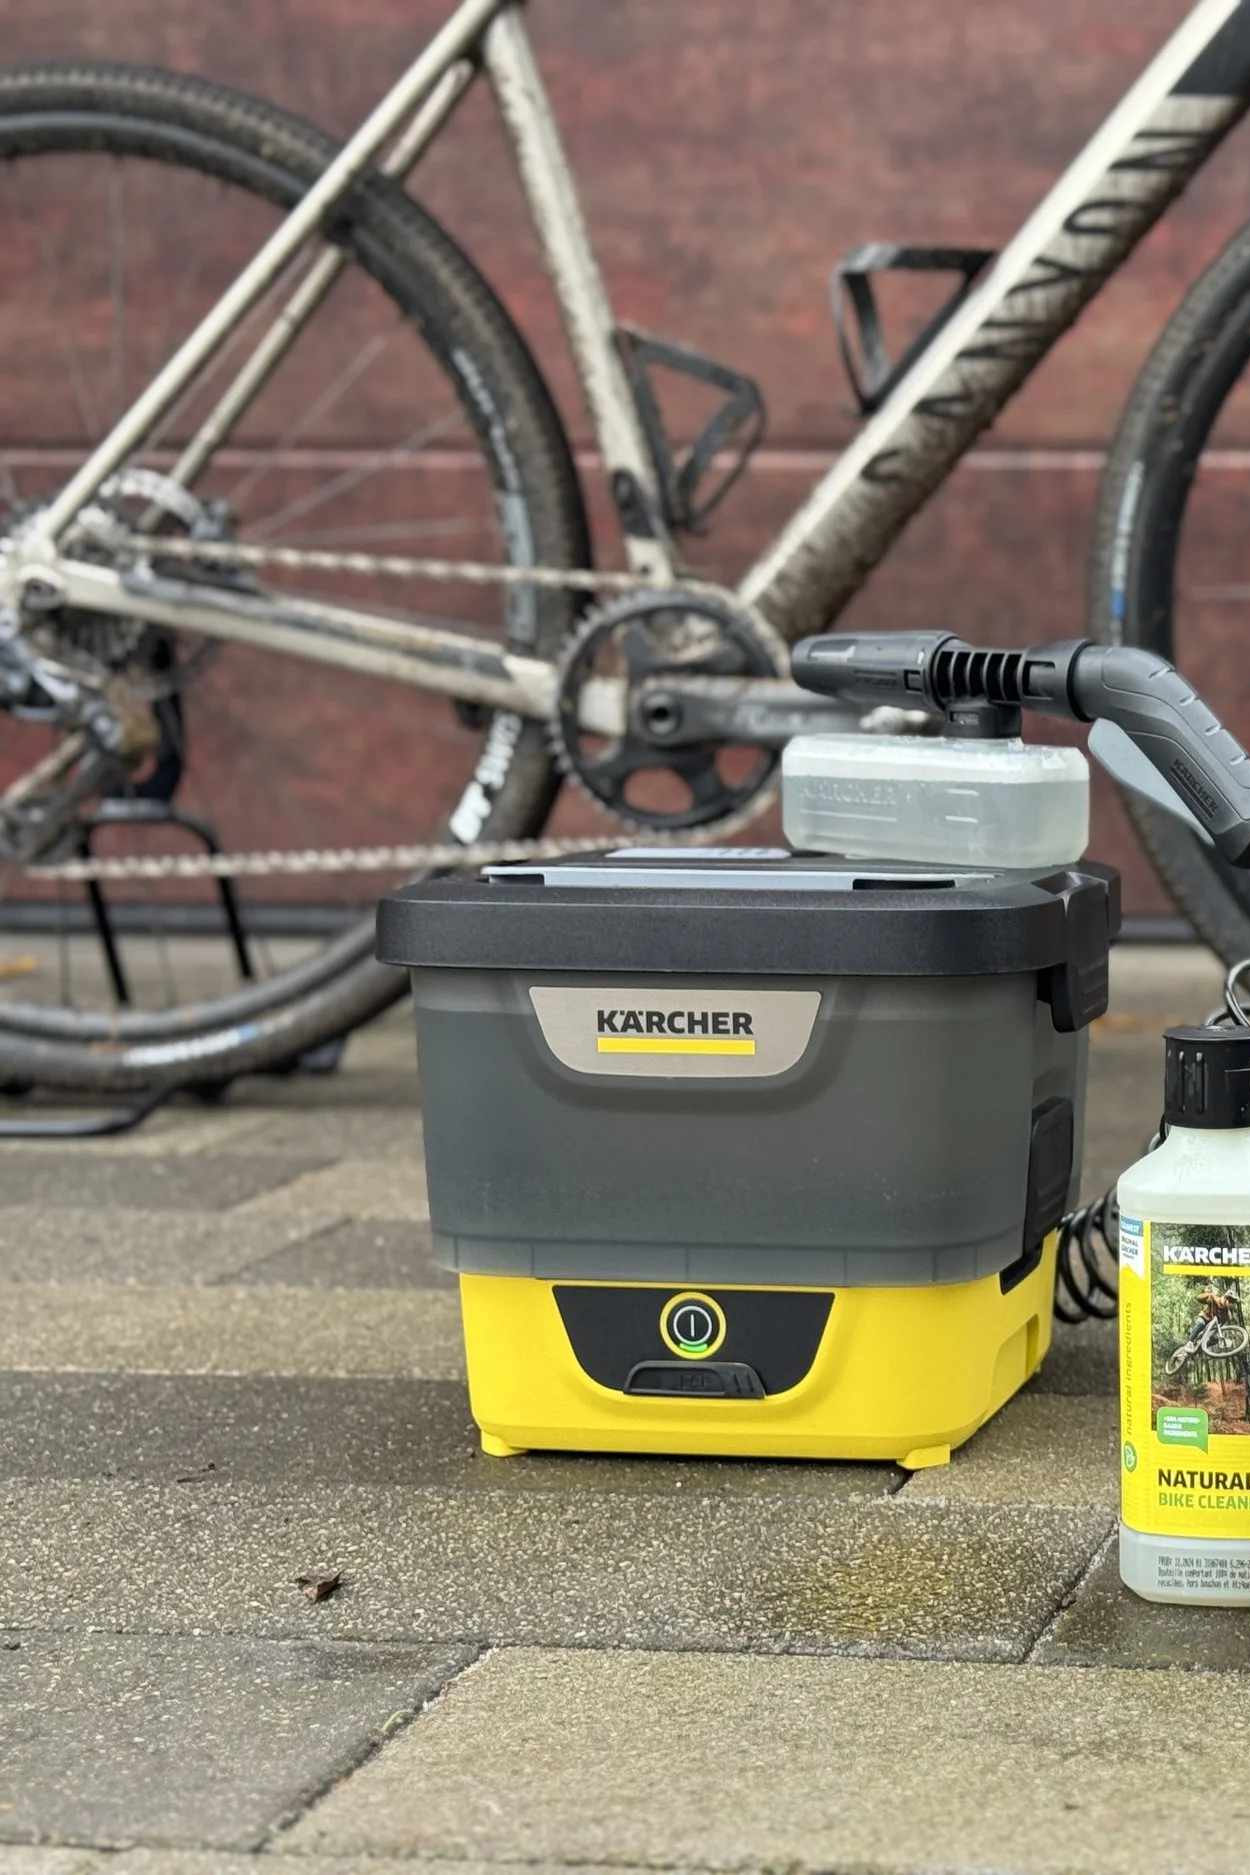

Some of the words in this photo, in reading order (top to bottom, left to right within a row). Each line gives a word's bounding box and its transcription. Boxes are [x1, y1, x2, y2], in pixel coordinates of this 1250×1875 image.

[860, 131, 1208, 483] CANYON
[597, 1009, 754, 1036] KÄRCHER
[1158, 1491, 1194, 1508] BIKE
